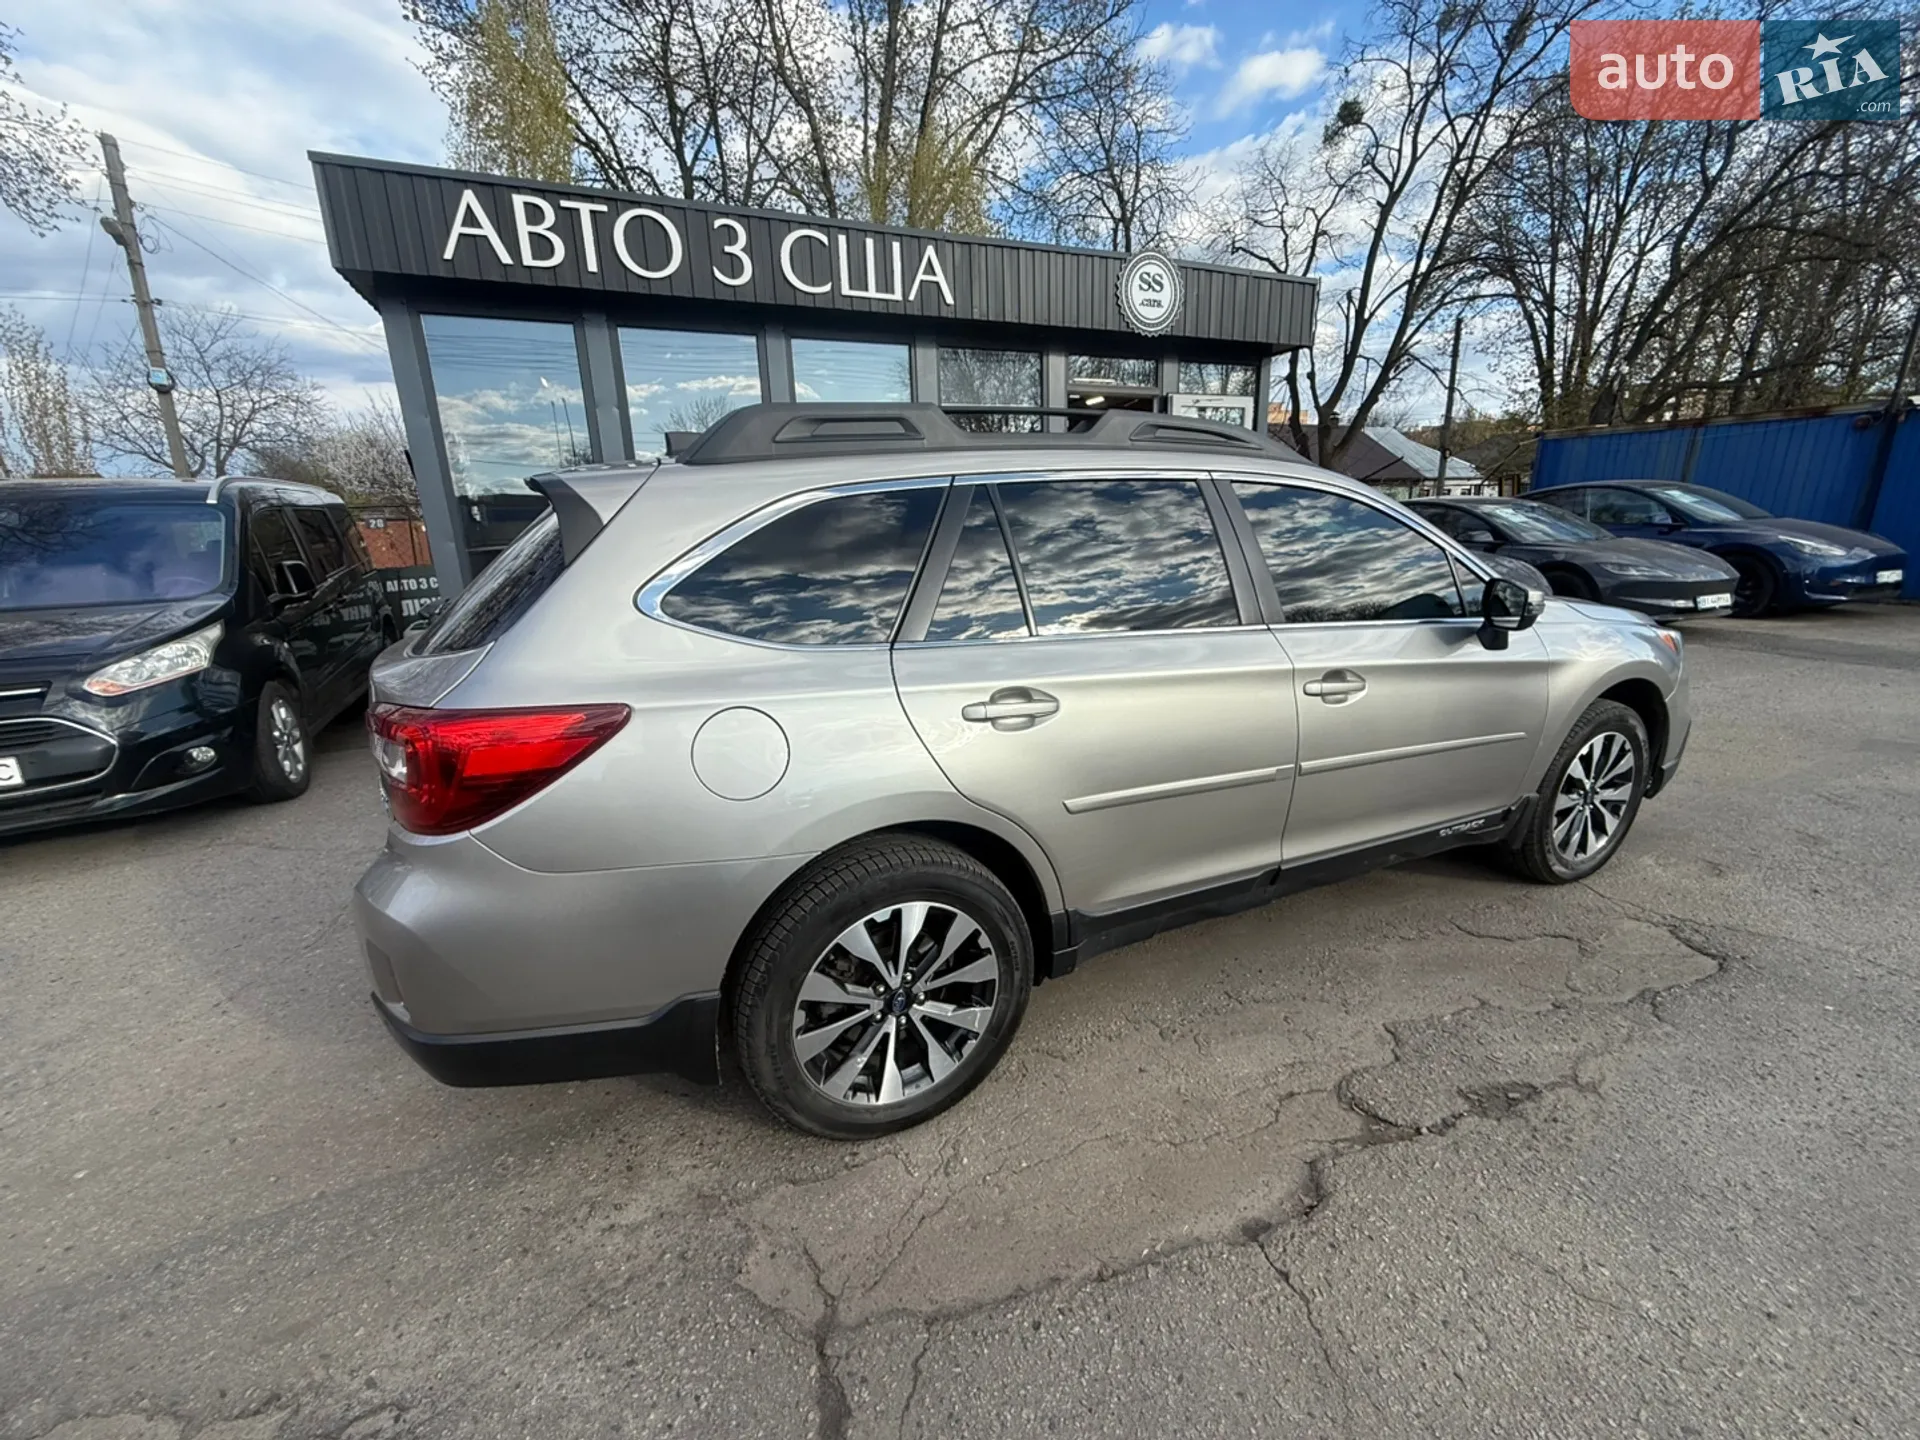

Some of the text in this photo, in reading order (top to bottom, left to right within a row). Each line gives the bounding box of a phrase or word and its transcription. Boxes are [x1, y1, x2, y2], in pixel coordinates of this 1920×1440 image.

[443, 189, 955, 306] АВТО З США
[1138, 271, 1164, 293] SS
